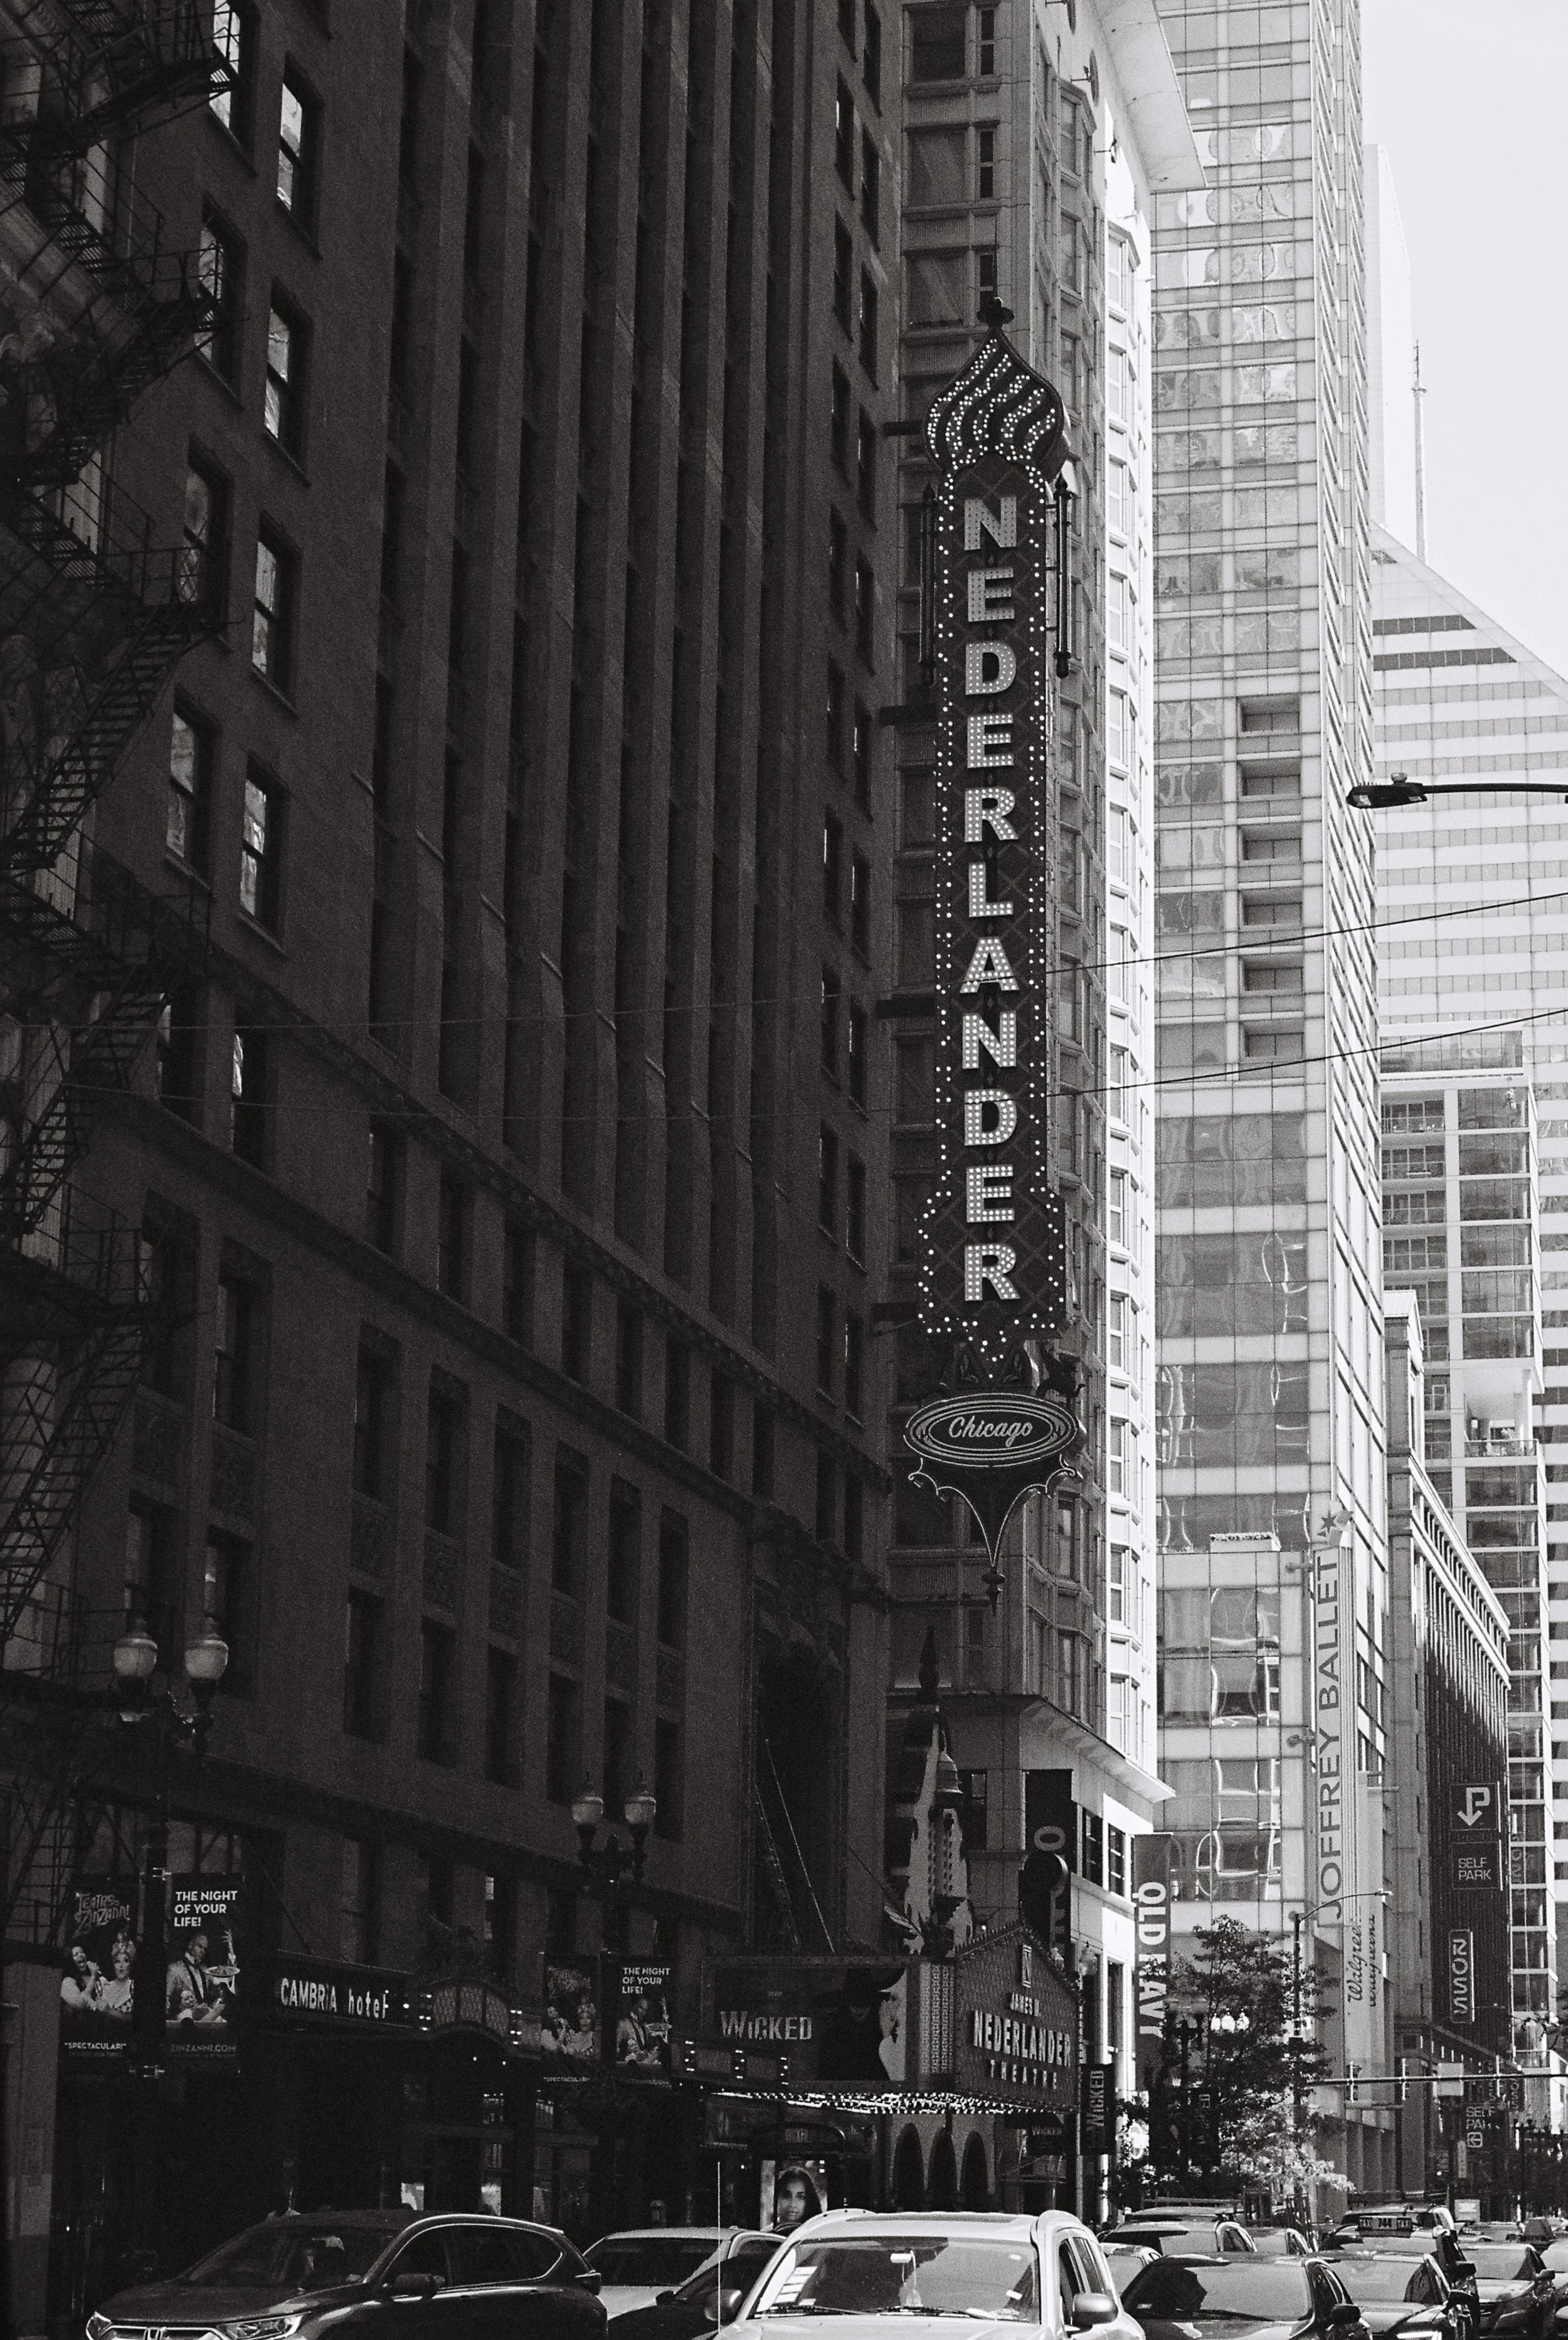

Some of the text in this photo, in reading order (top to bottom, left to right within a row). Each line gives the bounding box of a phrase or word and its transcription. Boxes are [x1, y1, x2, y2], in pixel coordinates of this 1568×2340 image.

[959, 497, 1020, 1302] NEDERLANDER
[948, 1415, 1034, 1448] Chicago
[1318, 1556, 1342, 1919] JOFFREY BALLET
[1458, 1857, 1488, 1869] SELF
[1458, 1870, 1492, 1881] PARK
[176, 1890, 238, 1902] THE NIGHT
[174, 1903, 226, 1914] OF YOUR
[173, 1916, 202, 1927] LIFE!
[622, 1967, 670, 1976] THE NIGHT
[622, 1976, 662, 1985] OF YOUR
[1451, 1938, 1469, 2014] ROSS
[622, 1986, 644, 1994] LIFE!
[347, 1988, 386, 2020] hotel
[1009, 1992, 1033, 2016] JAMES
[973, 2009, 1071, 2067] NEDERLANDER
[990, 2058, 1059, 2090] THEATRE
